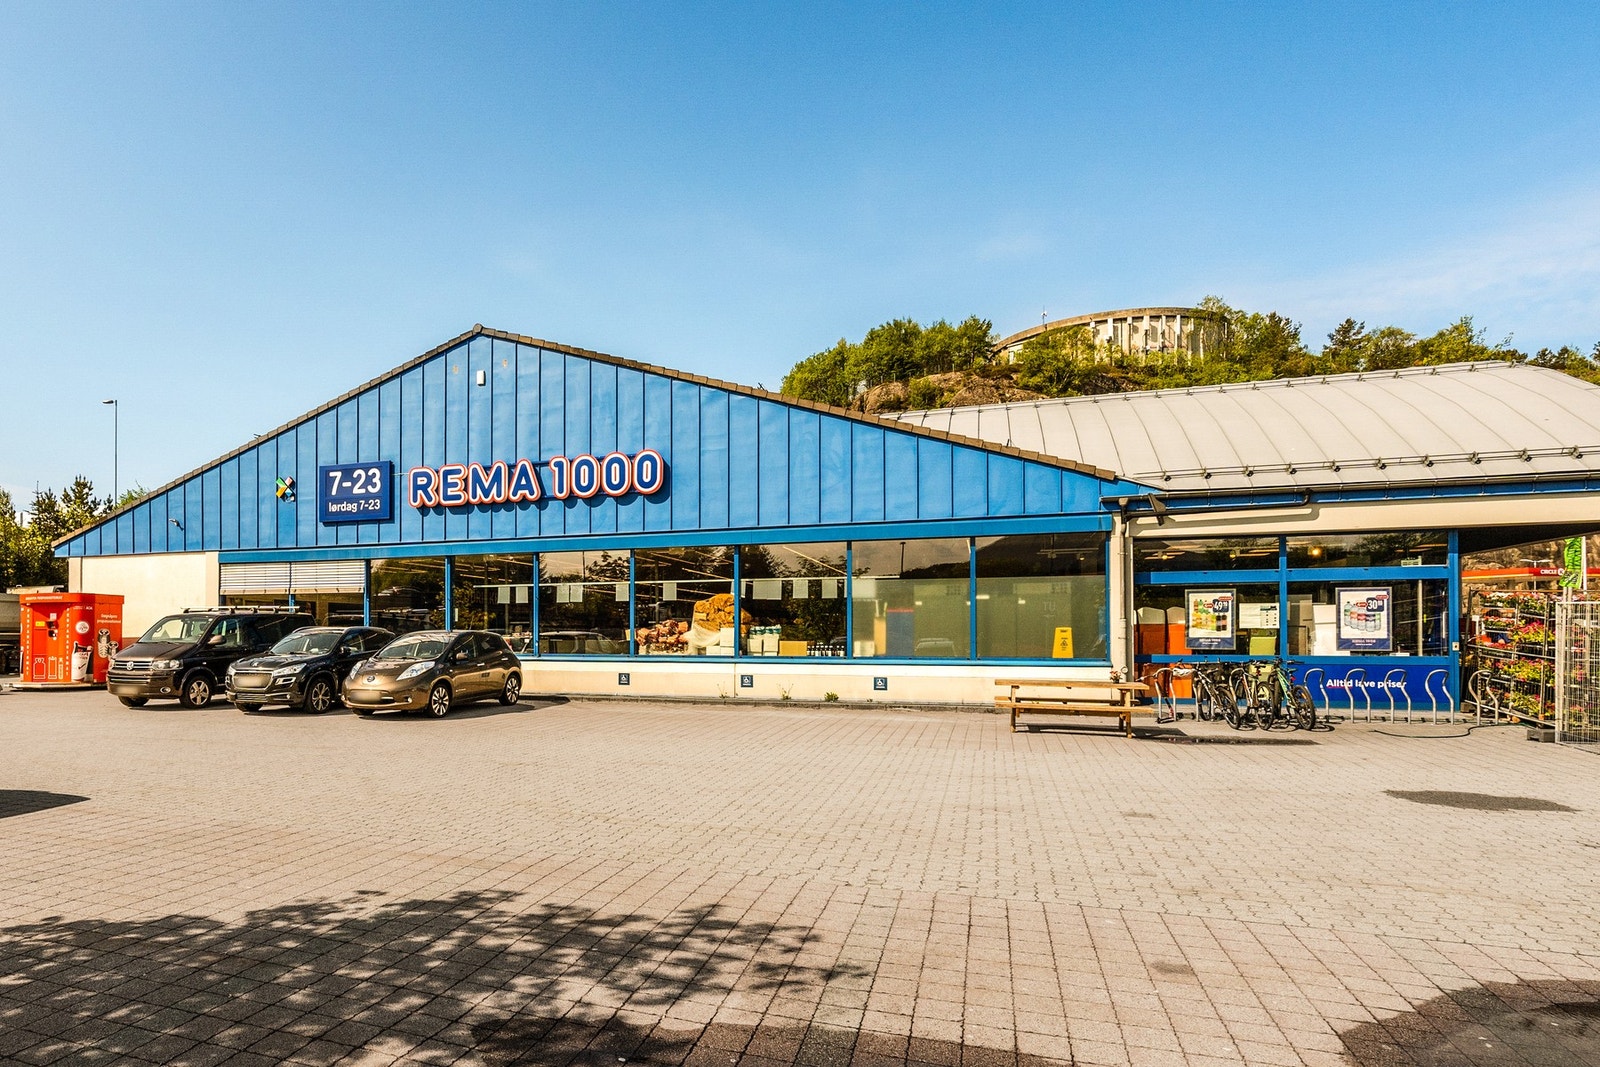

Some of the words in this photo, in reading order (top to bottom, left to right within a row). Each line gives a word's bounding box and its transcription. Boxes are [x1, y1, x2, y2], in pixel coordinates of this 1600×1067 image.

[328, 467, 382, 496] 7-23
[409, 458, 541, 508] REMA
[549, 449, 664, 500] 1000
[328, 501, 358, 513] lørdag
[359, 499, 381, 511] 7-23
[1214, 601, 1223, 610] 49
[1367, 599, 1378, 610] 30
[1355, 679, 1376, 688] lave
